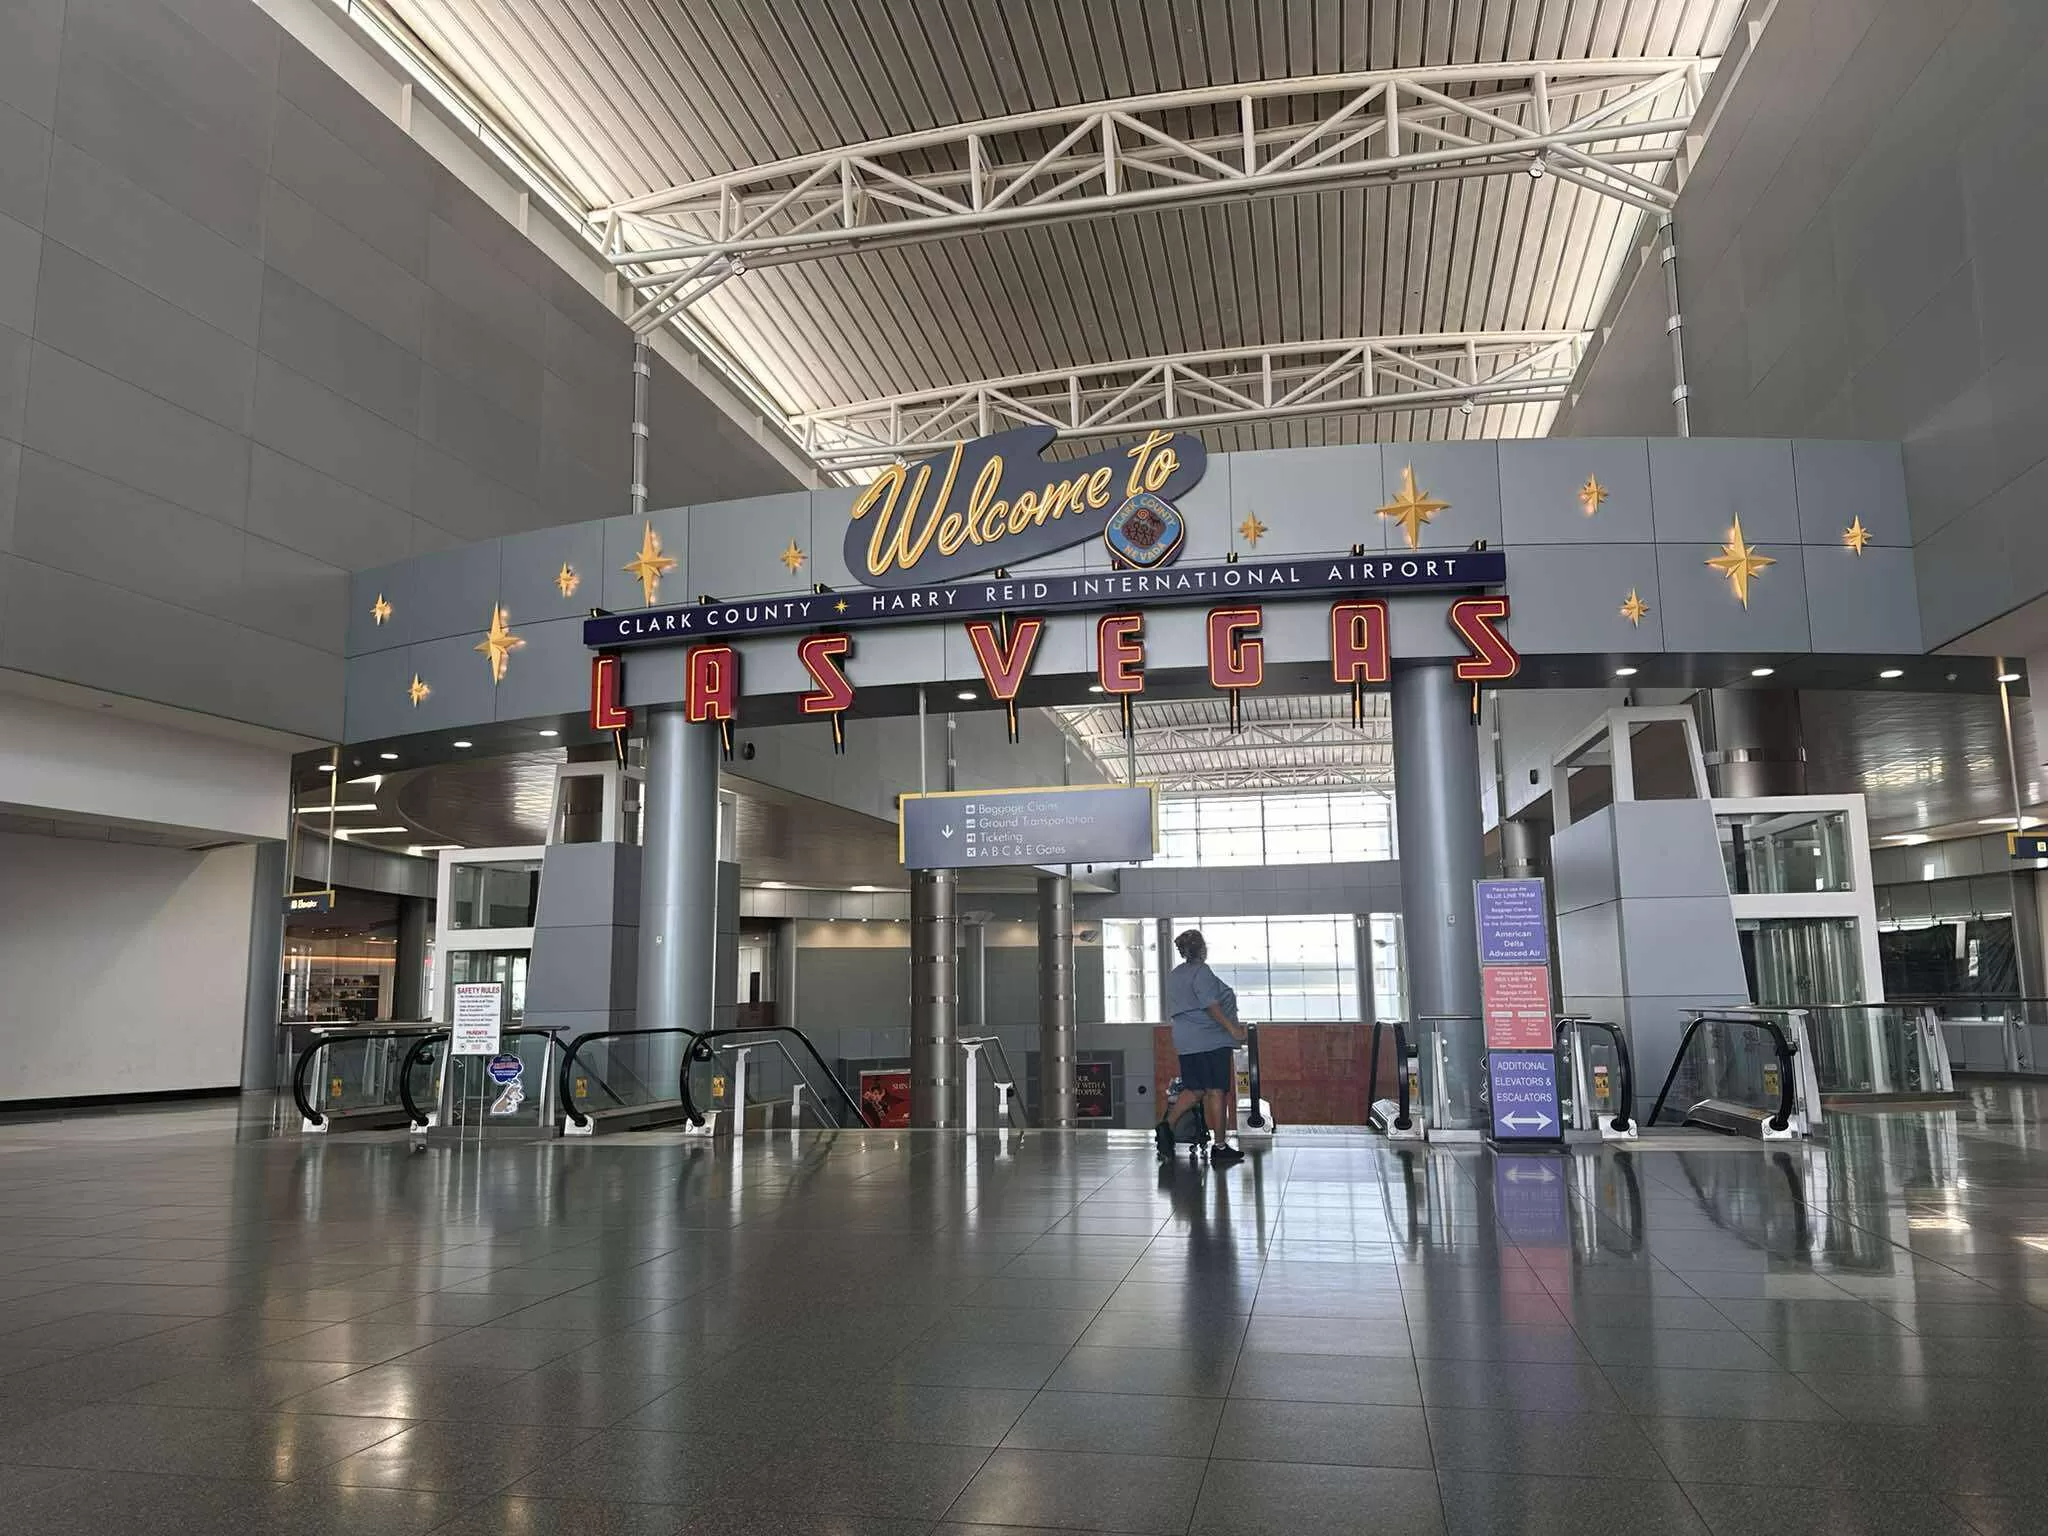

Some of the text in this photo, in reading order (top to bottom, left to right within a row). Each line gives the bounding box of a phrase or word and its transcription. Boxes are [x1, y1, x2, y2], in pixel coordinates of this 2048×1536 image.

[850, 430, 1180, 576] Welcome to
[1112, 496, 1177, 530] CLARK COUNTY
[1123, 543, 1167, 561] NEVADA
[618, 560, 1457, 635] CLARK COUNTY HARRY REID INTERNATIONAL AIRPORT
[590, 595, 1521, 732] LAS VEGAS
[979, 801, 1058, 816] Baggage Claim
[979, 816, 1095, 828] Ground Transportation
[980, 832, 1023, 843] Ticketing
[980, 844, 1066, 857] A B C & E Gates
[1489, 949, 1541, 957] Advanced Air
[480, 986, 500, 994] RULES
[1497, 1061, 1548, 1071] ADDITIONAL
[1495, 1076, 1552, 1087] ELEVATORS &
[1496, 1092, 1552, 1103] ESCALATORS
